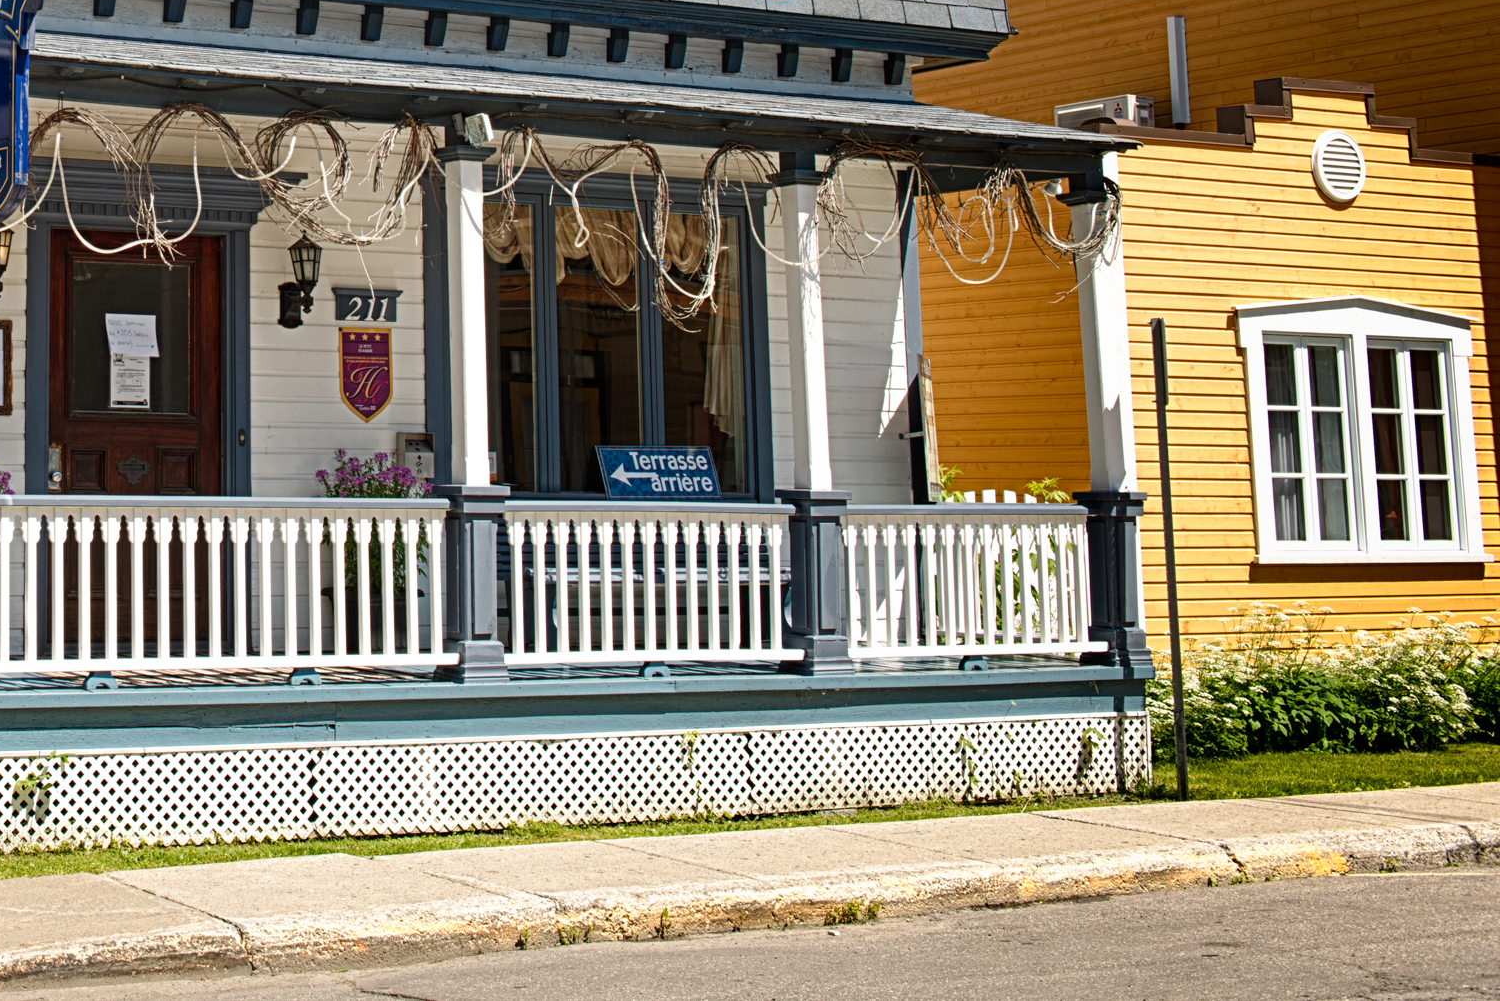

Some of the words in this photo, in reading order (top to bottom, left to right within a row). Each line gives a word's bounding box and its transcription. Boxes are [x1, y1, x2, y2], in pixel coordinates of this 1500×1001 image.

[344, 296, 389, 321] 211
[629, 451, 708, 471] Terrasse
[651, 473, 713, 492] arrière
